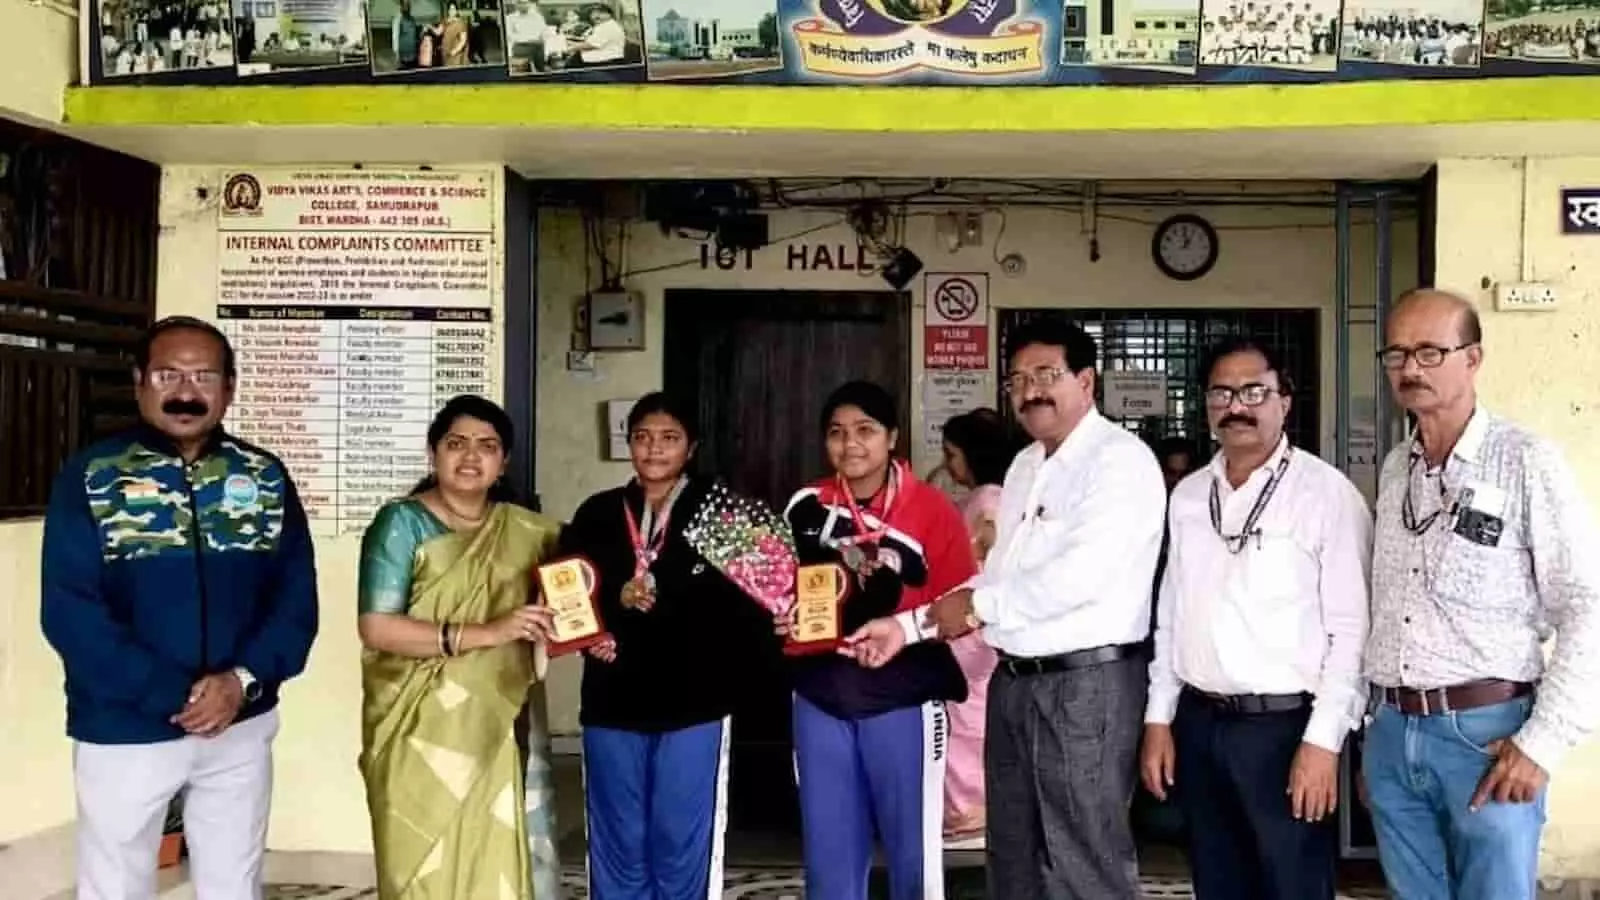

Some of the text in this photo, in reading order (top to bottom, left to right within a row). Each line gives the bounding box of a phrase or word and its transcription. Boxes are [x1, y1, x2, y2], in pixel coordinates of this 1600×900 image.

[267, 185, 295, 195] VIDYA
[298, 185, 329, 196] VIKAS
[367, 186, 425, 197] COMMERCE
[440, 187, 487, 198] SCIENCE
[366, 201, 439, 211] SAMUDRAPUR
[328, 215, 370, 225] WARDHA
[226, 236, 485, 252] INTERNAL COMPLAINTS COMMITTEE
[786, 244, 875, 271] HALL
[934, 712, 944, 760] INDIA
